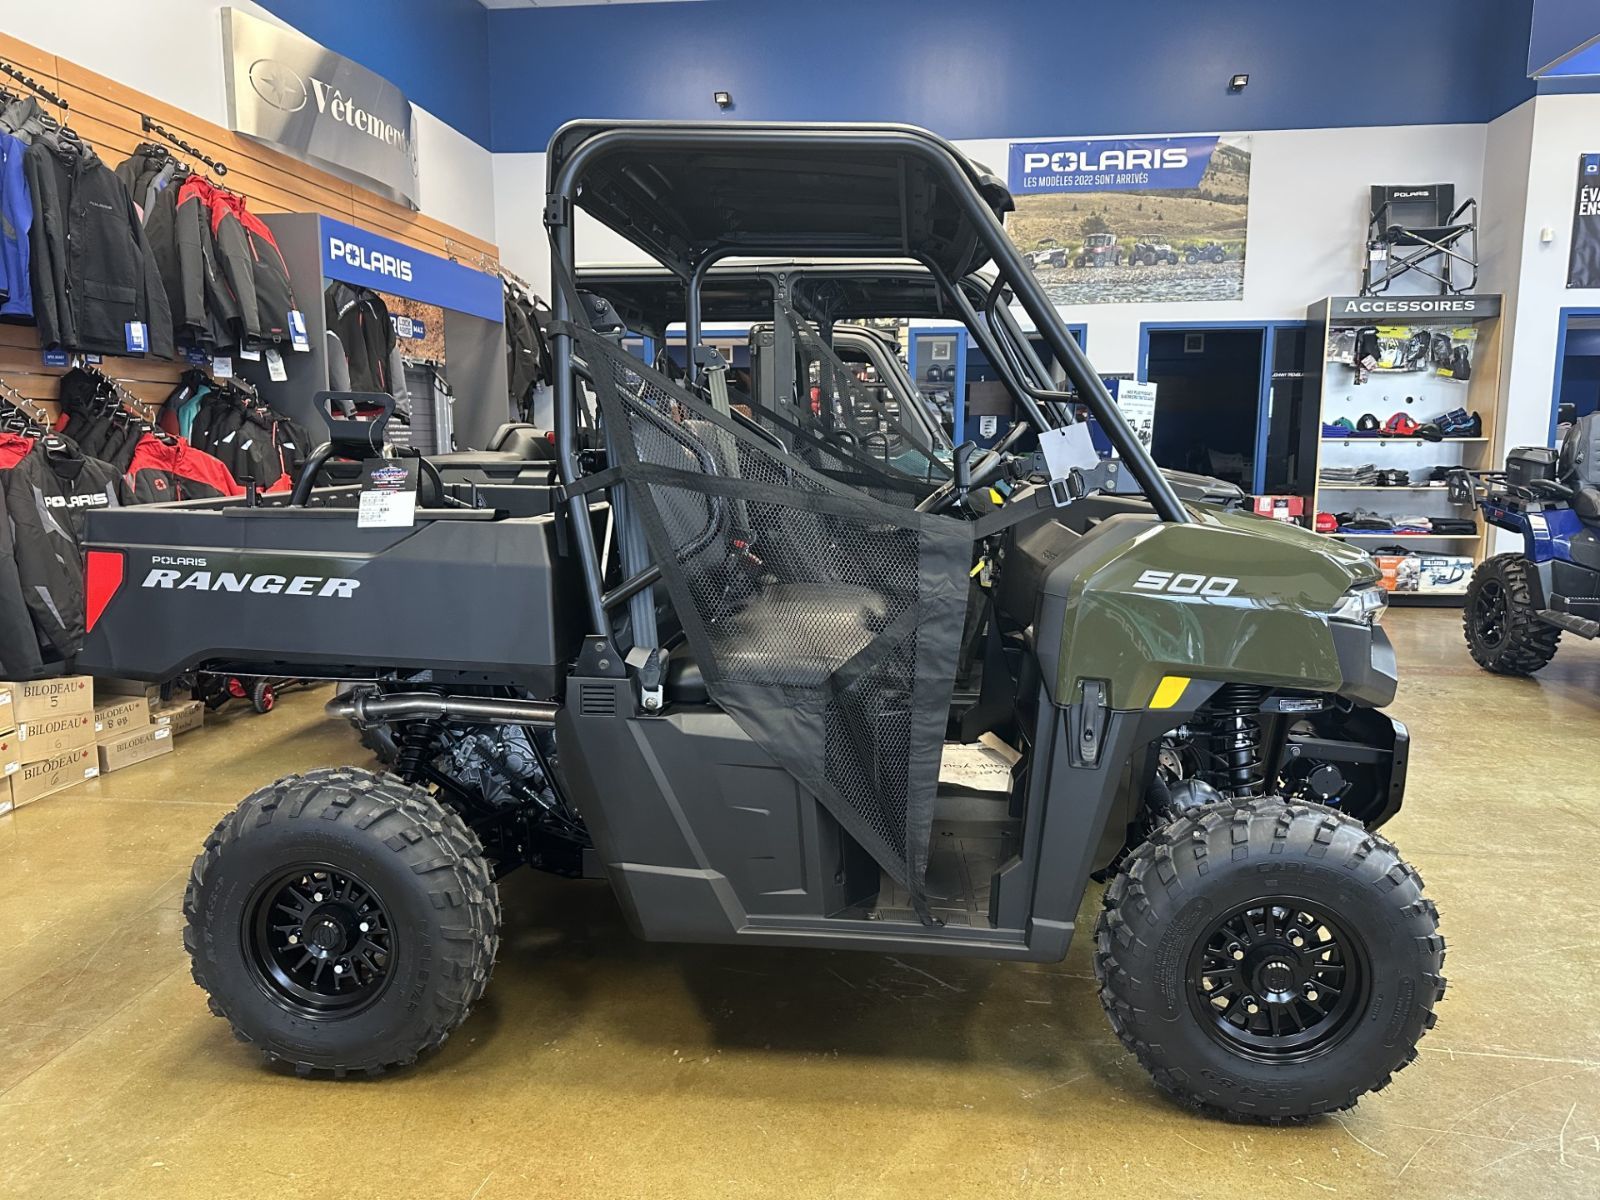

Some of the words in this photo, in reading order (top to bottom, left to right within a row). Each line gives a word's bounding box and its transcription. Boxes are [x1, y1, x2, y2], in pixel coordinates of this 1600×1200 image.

[308, 77, 408, 153] Vêtement
[1024, 148, 1188, 173] POLARIS
[1024, 177, 1037, 187] LES
[1038, 175, 1073, 187] MODÈLES
[1074, 174, 1093, 185] 2022
[1095, 174, 1114, 184] SONT
[1115, 172, 1148, 184] ARRIVÉS
[329, 237, 413, 282] POLARIS
[1345, 300, 1475, 313] ACCESSOIRES
[44, 493, 108, 508] POLARIS
[152, 556, 207, 567] POLARIS
[141, 569, 361, 598] RANGER
[1132, 570, 1239, 597] 500
[24, 681, 78, 698] BILODEAU
[50, 696, 59, 708] 5
[95, 703, 135, 723] BILODEAU
[28, 717, 82, 737] BILODEAU
[24, 752, 81, 781] BILODEAU
